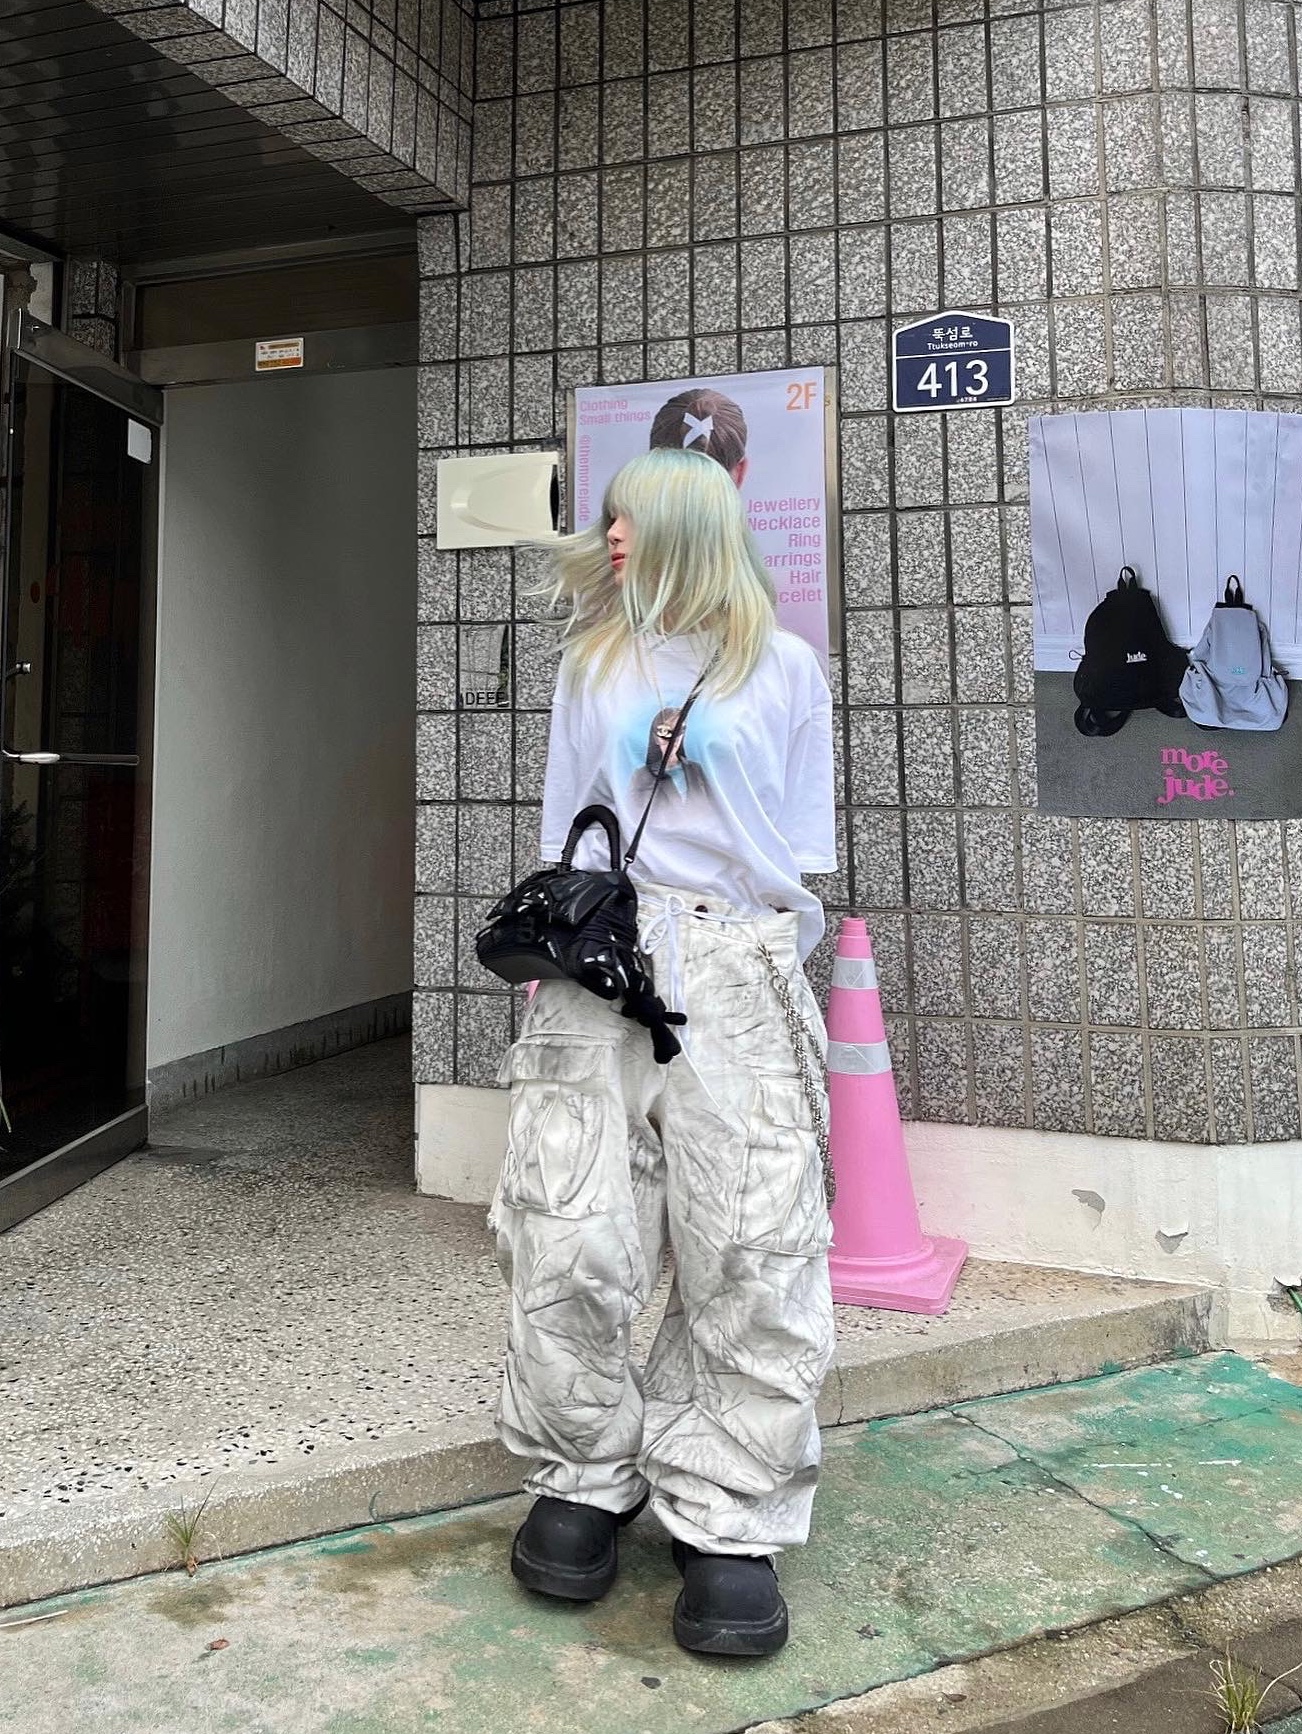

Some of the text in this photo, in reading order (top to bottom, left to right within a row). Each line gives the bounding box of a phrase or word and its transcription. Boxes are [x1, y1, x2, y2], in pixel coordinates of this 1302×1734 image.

[932, 326, 973, 341] 뚝섬로
[927, 340, 978, 350] Ttukseom-ro
[917, 360, 989, 398] 413
[786, 382, 817, 411] 2F
[580, 400, 628, 412] Clothing
[580, 411, 651, 425] Small things
[748, 497, 820, 513] Jewellery
[748, 516, 820, 530] Necklace
[788, 533, 820, 547] Ring
[764, 552, 821, 567] arrings
[790, 570, 821, 584] Hair
[778, 588, 822, 603] celet
[1161, 748, 1229, 775] more
[1157, 769, 1235, 804] jude.
